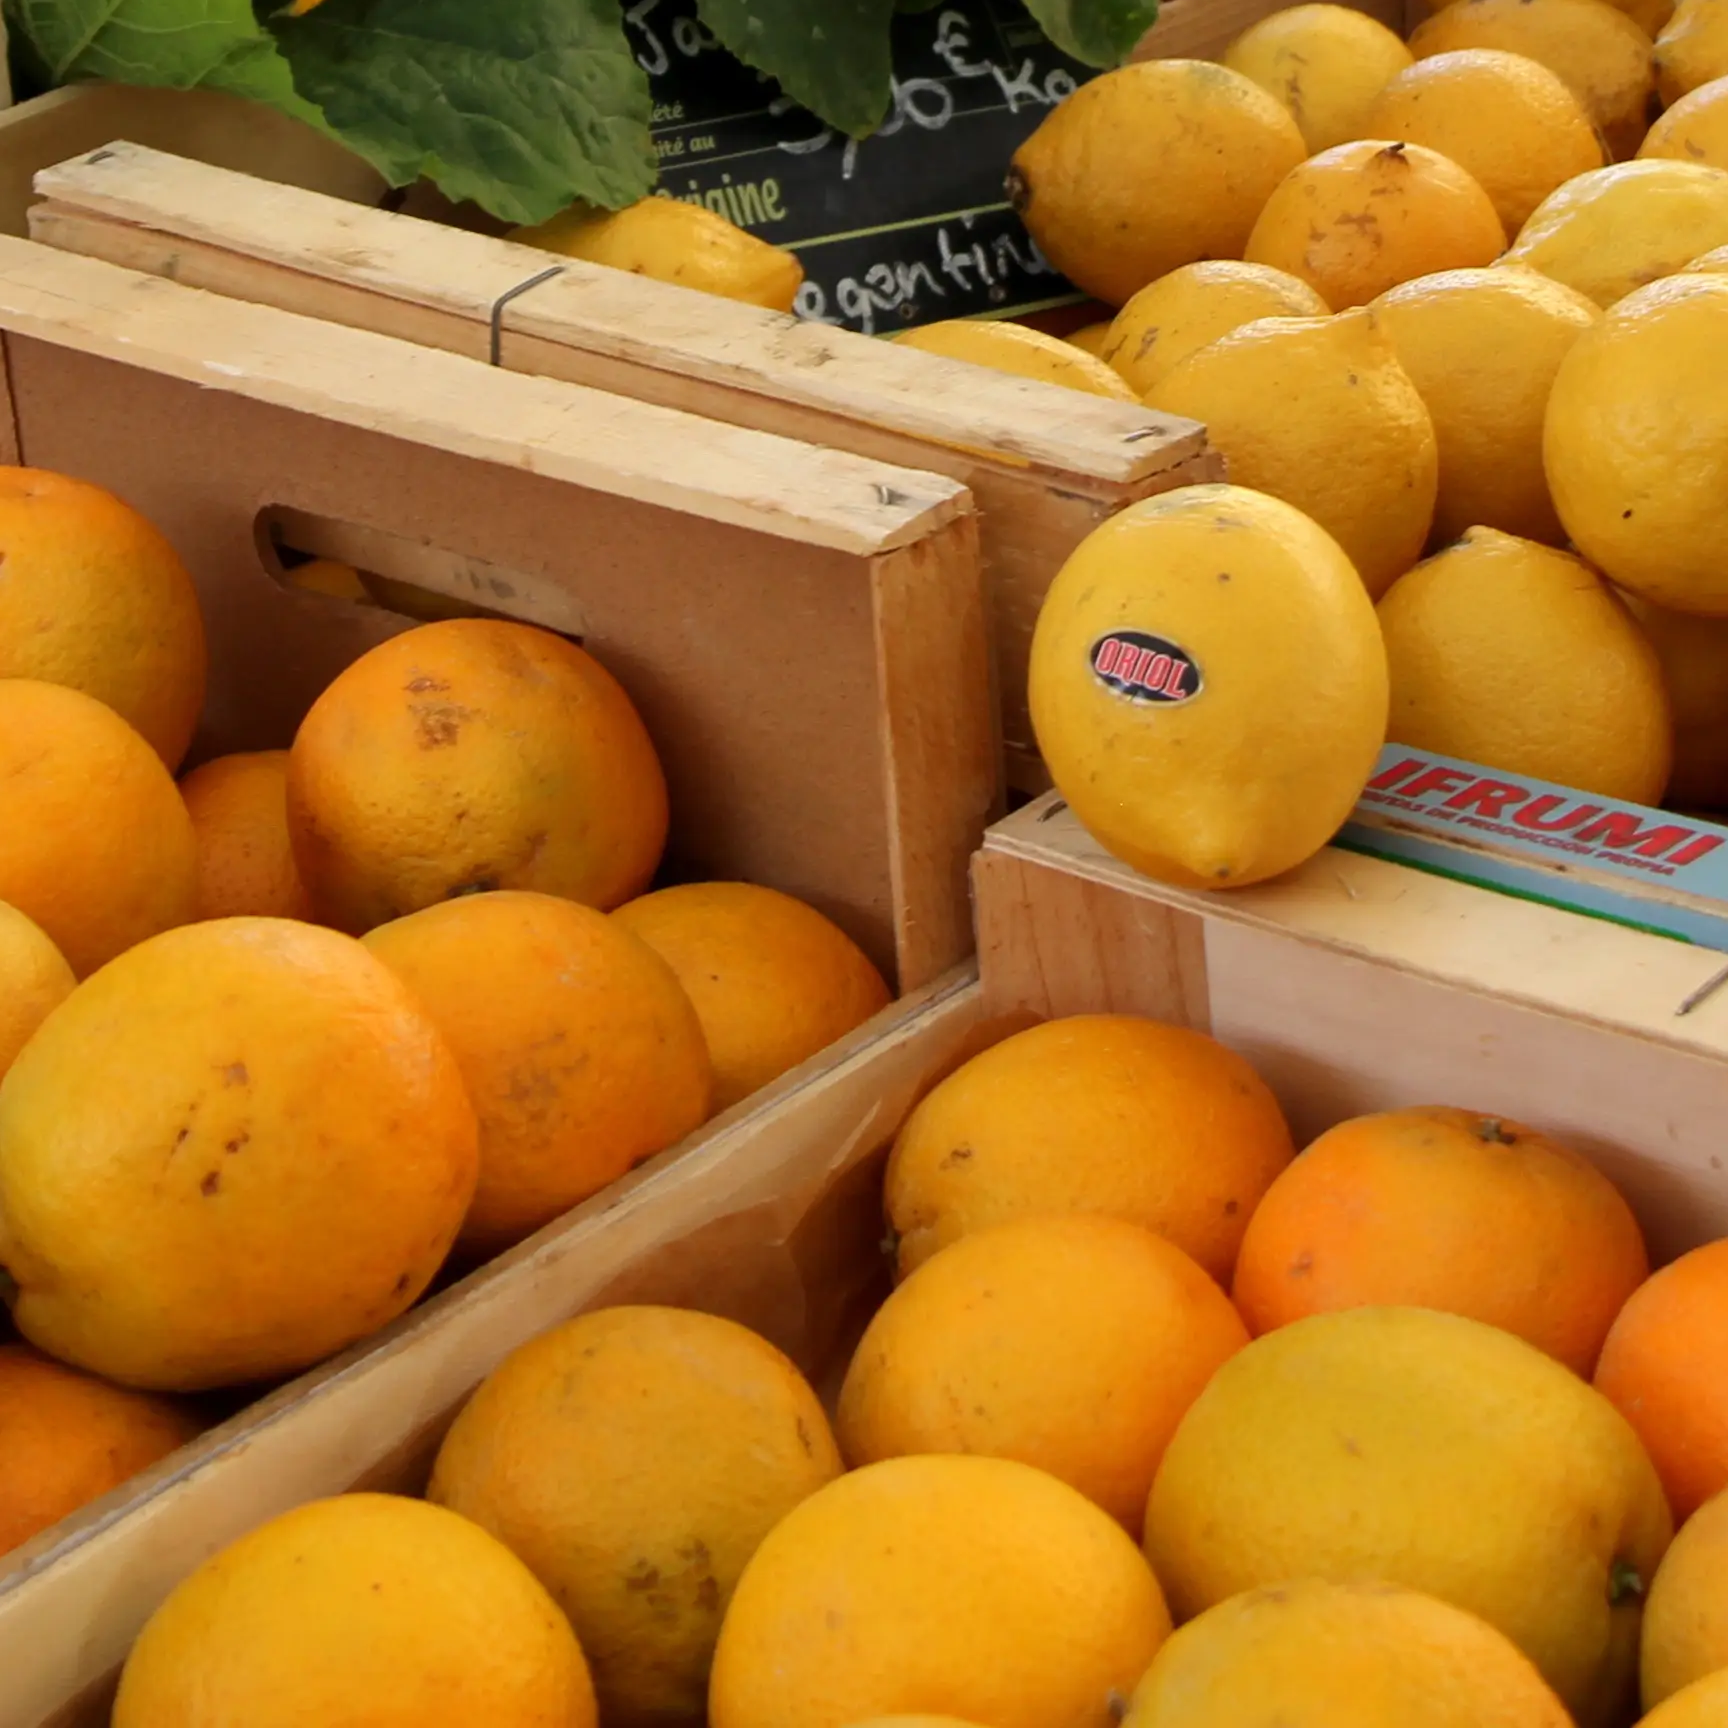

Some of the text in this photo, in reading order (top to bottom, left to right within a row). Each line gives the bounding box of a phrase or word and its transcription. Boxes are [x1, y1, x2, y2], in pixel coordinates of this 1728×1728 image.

[689, 134, 716, 153] au
[1095, 638, 1190, 700] ORIOL
[1367, 758, 1726, 866] IFRUMI
